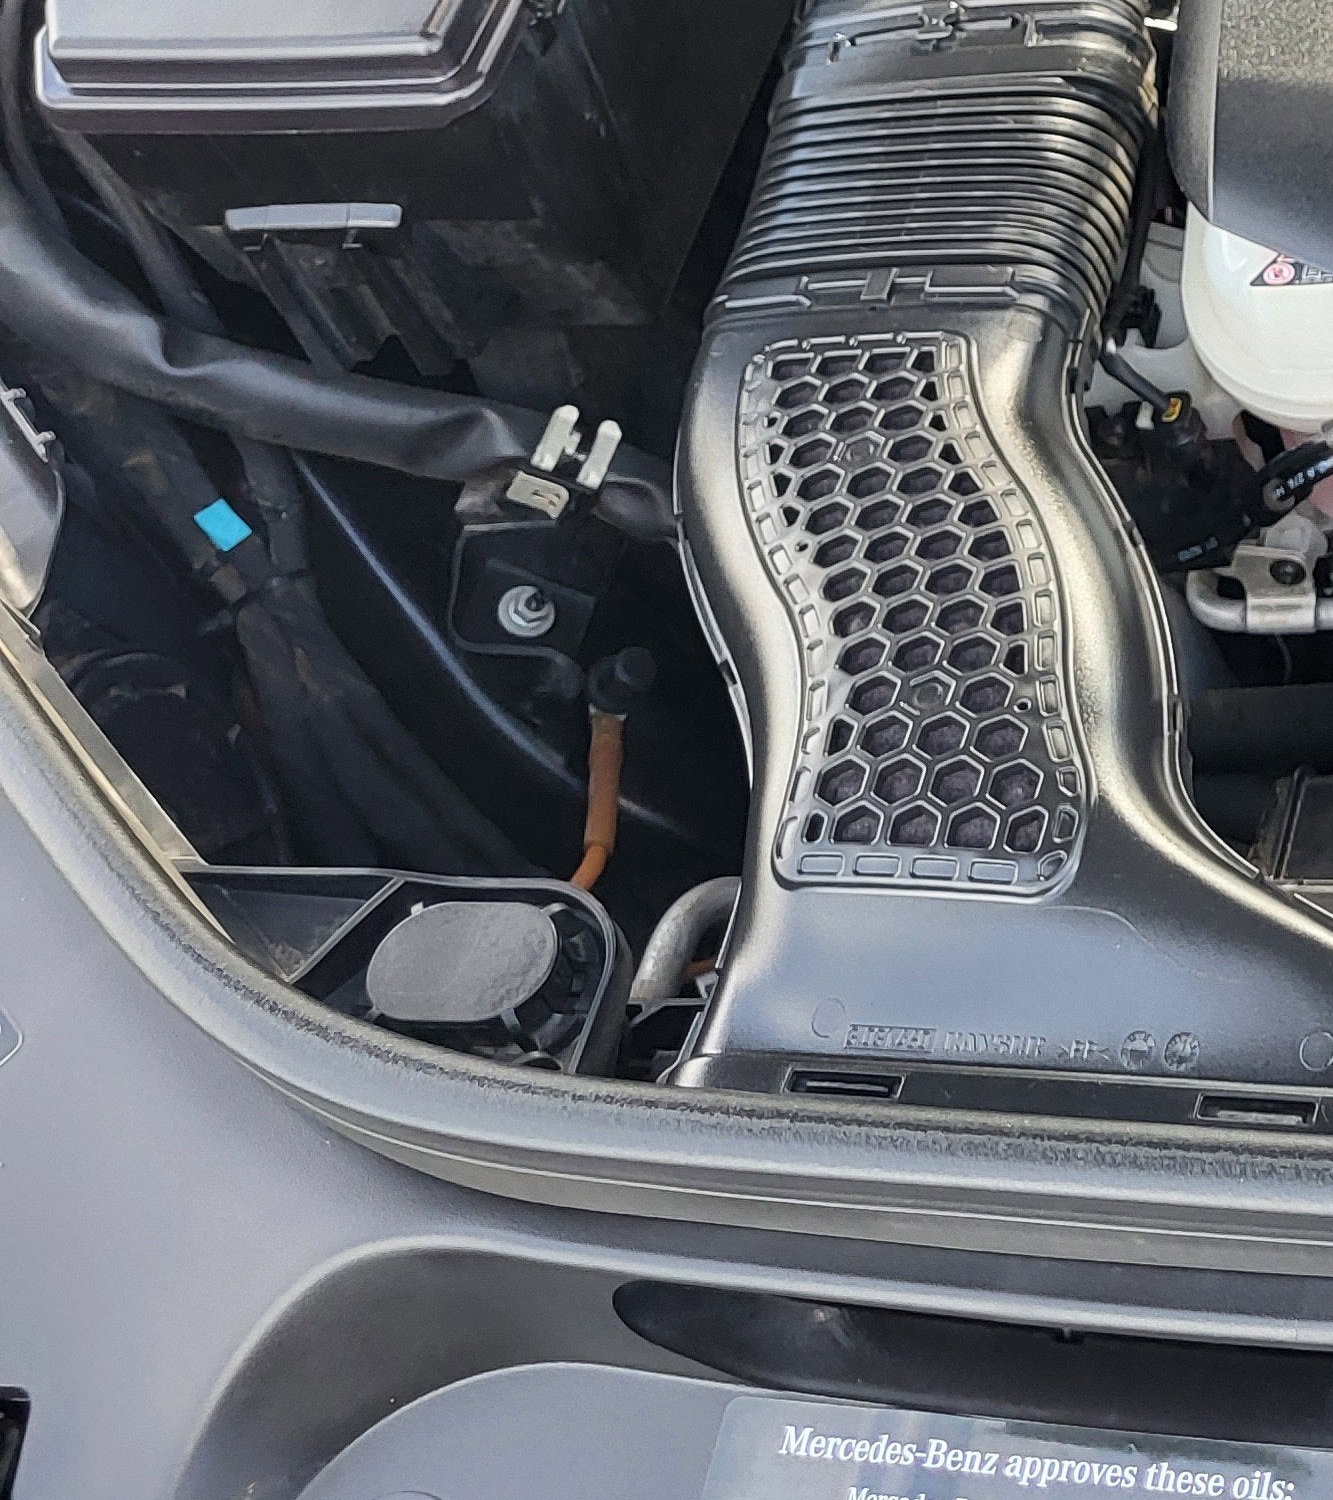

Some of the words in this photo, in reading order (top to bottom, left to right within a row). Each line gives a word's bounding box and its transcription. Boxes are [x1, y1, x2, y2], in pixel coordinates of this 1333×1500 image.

[778, 1425, 1001, 1476] Mercedes-Benz
[1004, 1453, 1139, 1489] approves
[1145, 1461, 1226, 1497] these
[1232, 1471, 1297, 1500] oils:
